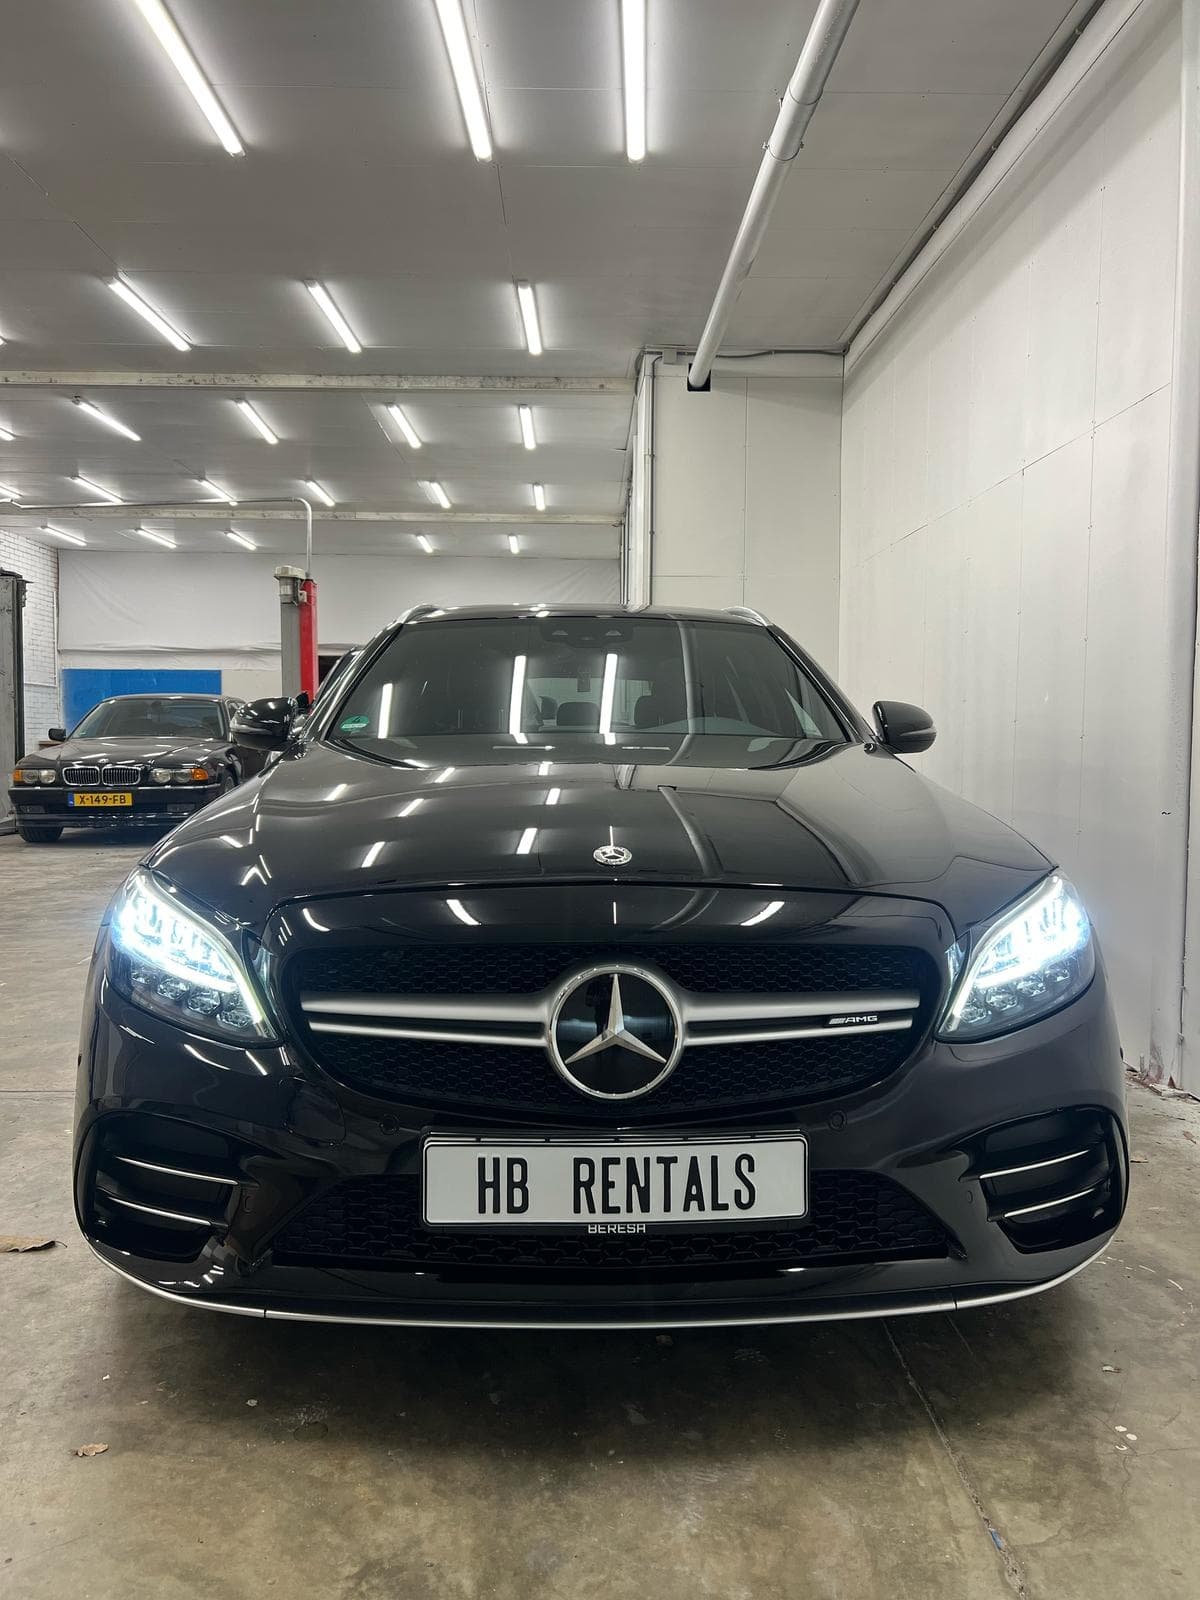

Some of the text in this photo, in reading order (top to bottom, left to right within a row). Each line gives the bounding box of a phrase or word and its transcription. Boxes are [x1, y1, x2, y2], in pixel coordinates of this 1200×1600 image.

[79, 795, 126, 805] X-149-FB
[845, 1015, 878, 1024] AMG
[477, 1153, 757, 1215] HB RENTALS
[588, 1223, 646, 1234] BERESA
